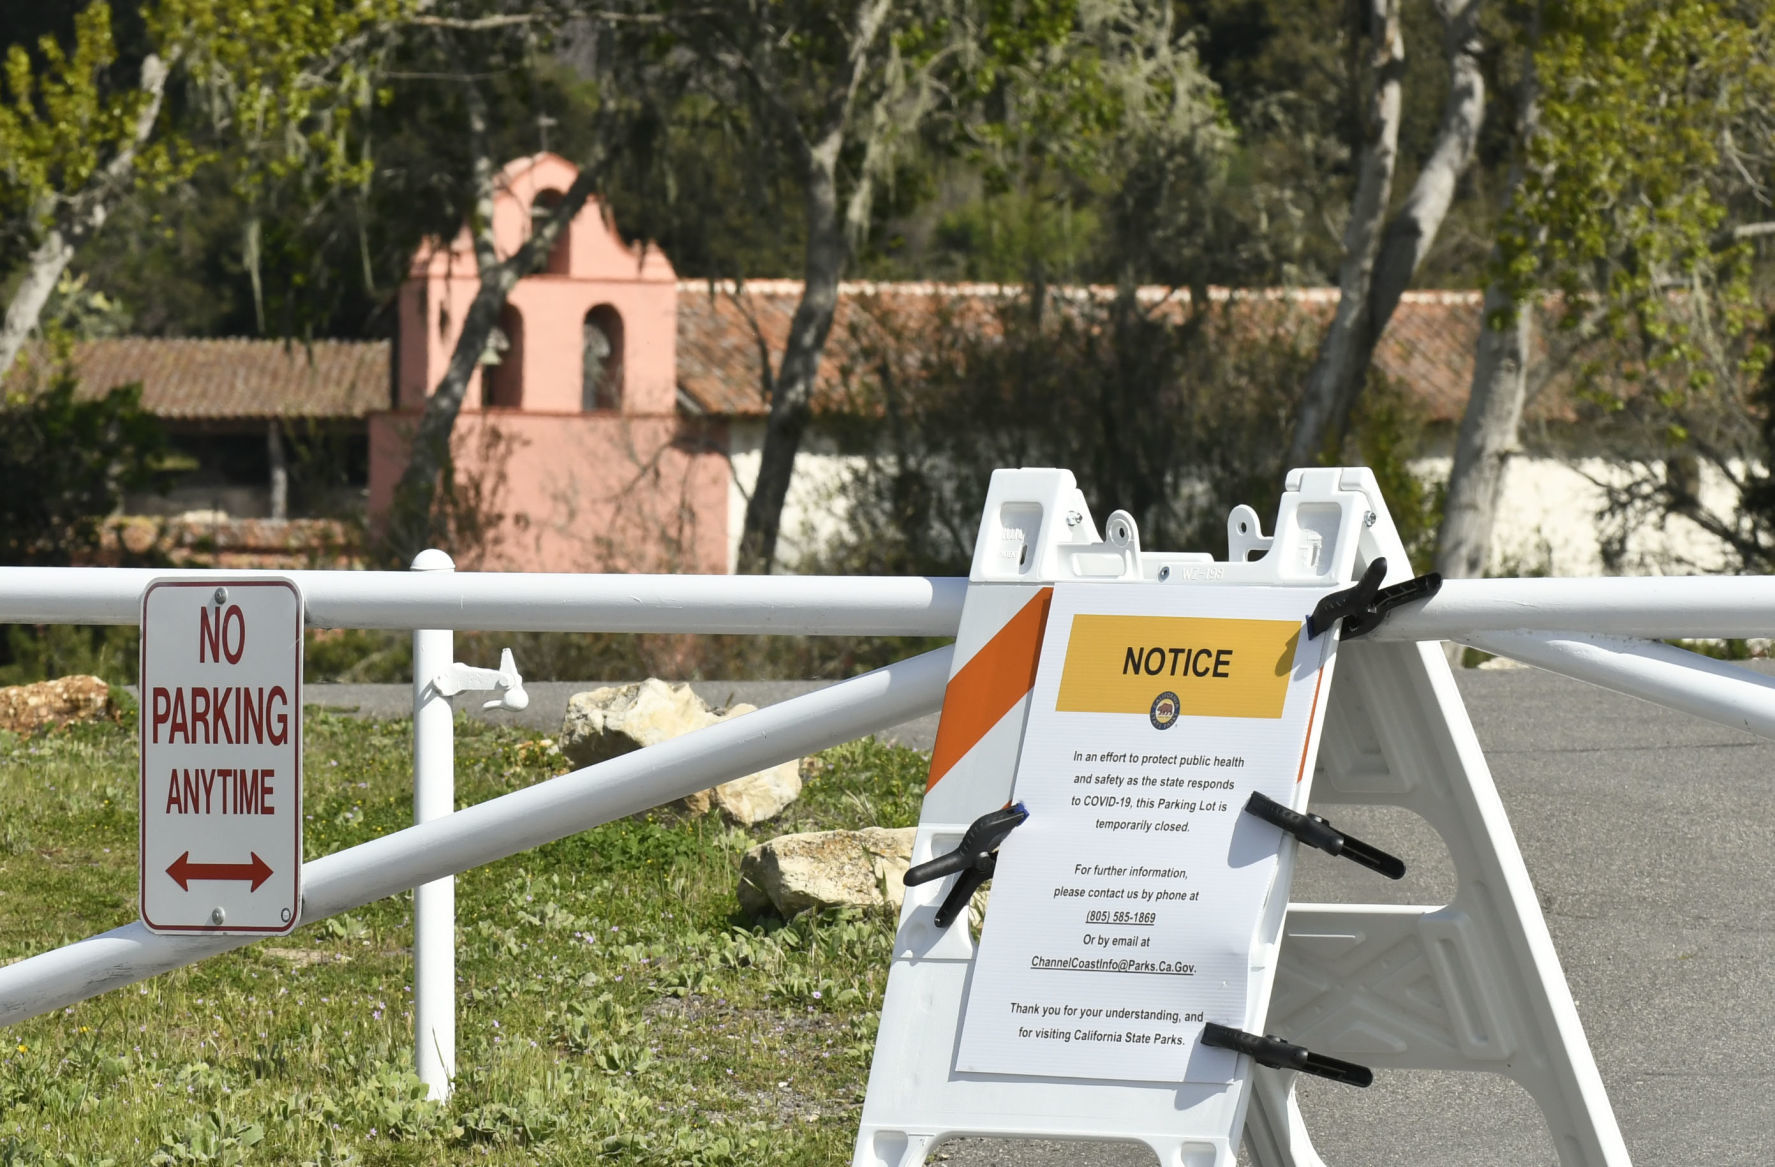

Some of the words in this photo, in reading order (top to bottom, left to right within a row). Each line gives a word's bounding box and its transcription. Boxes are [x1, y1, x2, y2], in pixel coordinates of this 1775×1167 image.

[200, 605, 245, 665] NO
[1123, 647, 1233, 678] NOTICE
[153, 685, 288, 746] PARKING
[1073, 750, 1083, 761] In
[1085, 754, 1097, 762] an
[1100, 751, 1127, 763] effort
[1129, 753, 1139, 763] to
[1141, 754, 1178, 767] protect
[1179, 755, 1211, 768] public
[1213, 756, 1244, 767] health
[1073, 773, 1093, 784] and
[1094, 774, 1125, 788] safety
[1127, 777, 1138, 786] as
[1141, 776, 1157, 786] the
[1160, 777, 1185, 787] state
[1187, 779, 1235, 791] responds
[166, 769, 275, 815] ANYTIME
[1071, 796, 1081, 806] to
[1084, 795, 1132, 808] COVID-19,
[1136, 798, 1155, 809] this
[1157, 798, 1197, 813] Parking
[1199, 800, 1216, 811] Lot
[1218, 801, 1227, 812] is
[1096, 819, 1152, 833] temporarily
[1154, 821, 1190, 832] closed.
[1074, 864, 1092, 875] For
[1094, 864, 1128, 876] further
[1129, 866, 1188, 880] information,
[1053, 886, 1086, 899] please
[1088, 888, 1125, 899] contact
[1127, 891, 1139, 899] us
[1141, 889, 1154, 902] by
[1155, 889, 1187, 902] phone
[1189, 891, 1199, 901] at
[1085, 910, 1110, 925] (805)
[1111, 911, 1156, 926] 585-1869
[1083, 934, 1096, 945] Or
[1097, 934, 1110, 948] by
[1112, 936, 1139, 947] email
[1140, 937, 1150, 947] at
[1030, 955, 1197, 975] ChannelCoastInfo@Parks.Ca.Gov.
[1010, 1002, 1040, 1014] Thank
[1041, 1006, 1061, 1019] you
[1063, 1005, 1078, 1016] for
[1079, 1008, 1103, 1020] your
[1105, 1008, 1181, 1024] understanding,
[1184, 1011, 1204, 1022] and
[1019, 1026, 1033, 1038] for
[1035, 1028, 1071, 1043] visiting
[1074, 1029, 1122, 1042] California
[1125, 1032, 1151, 1044] State
[1153, 1033, 1185, 1045] Parks.
